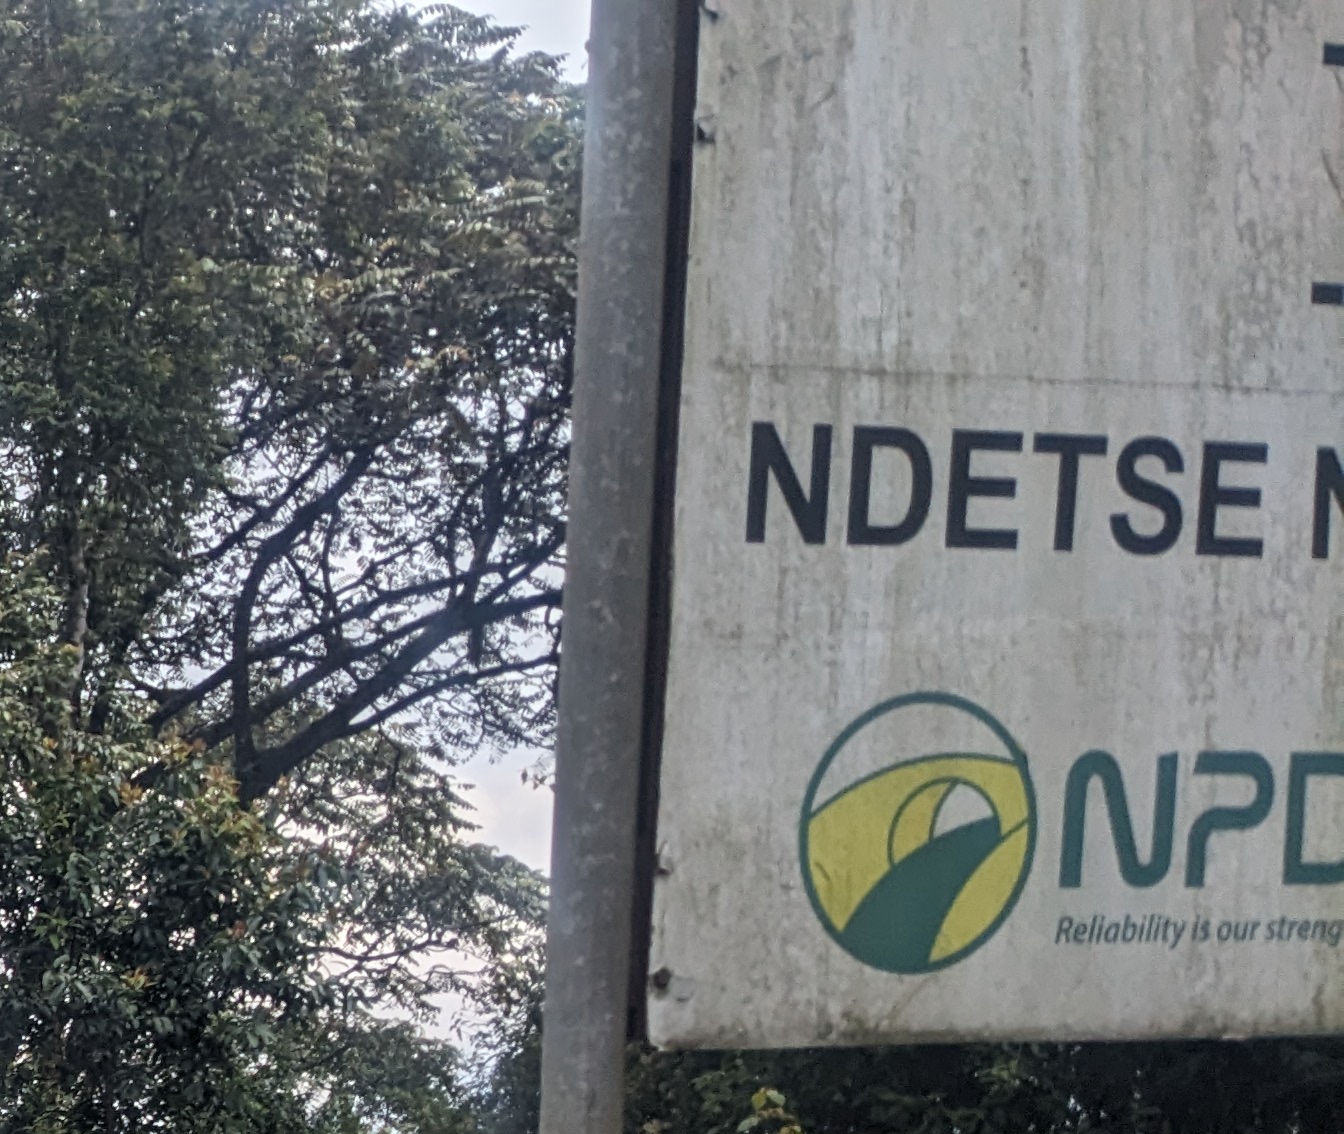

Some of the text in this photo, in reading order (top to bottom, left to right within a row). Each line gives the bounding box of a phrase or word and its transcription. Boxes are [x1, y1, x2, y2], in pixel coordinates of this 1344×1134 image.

[745, 421, 1269, 559] NDETSE
[1054, 914, 1187, 950] Reliability
[1191, 914, 1211, 942] is
[1216, 919, 1261, 942] our
